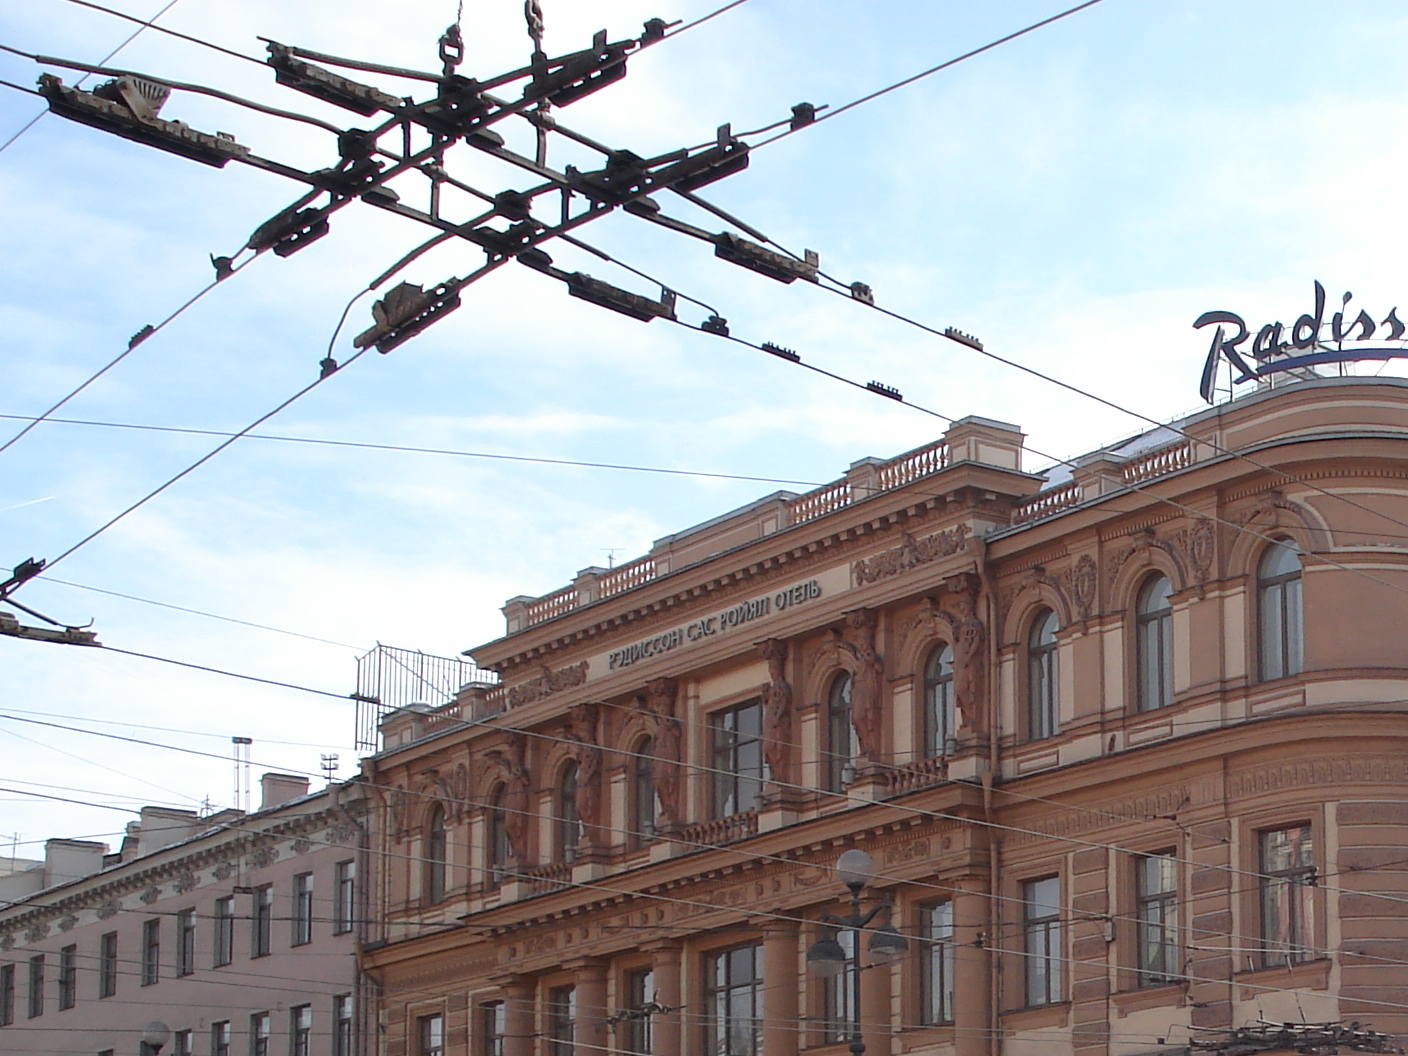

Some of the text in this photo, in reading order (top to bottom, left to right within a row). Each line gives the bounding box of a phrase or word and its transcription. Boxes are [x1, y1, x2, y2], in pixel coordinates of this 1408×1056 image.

[608, 579, 821, 670] РЭДИССОН САС РОЙЯЛ ОТЕЛЬ
